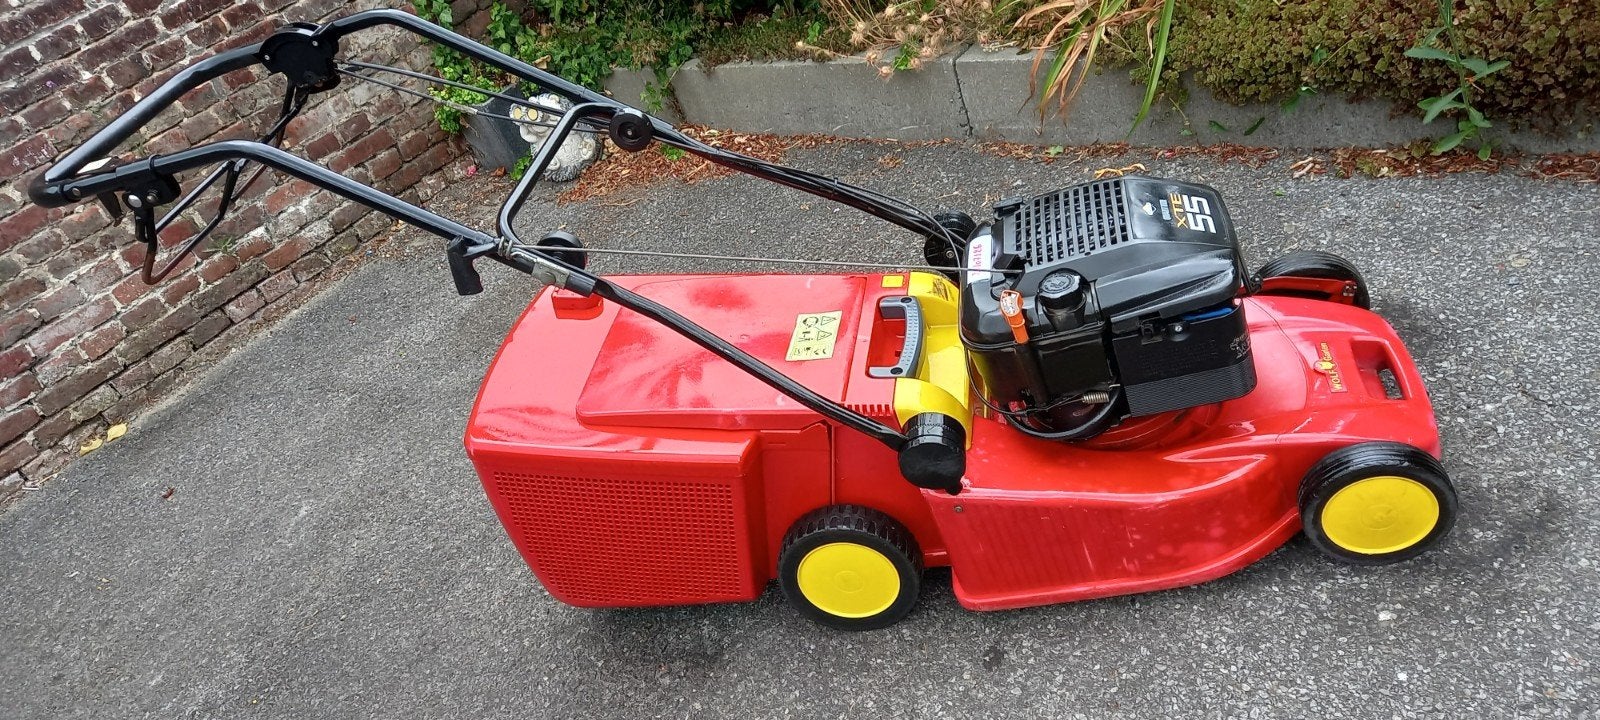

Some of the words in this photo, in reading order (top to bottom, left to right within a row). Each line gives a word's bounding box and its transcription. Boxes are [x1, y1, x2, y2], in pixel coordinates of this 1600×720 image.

[1170, 193, 1189, 228] XTE
[1182, 194, 1217, 234] 55
[1329, 370, 1343, 390] WOLF
